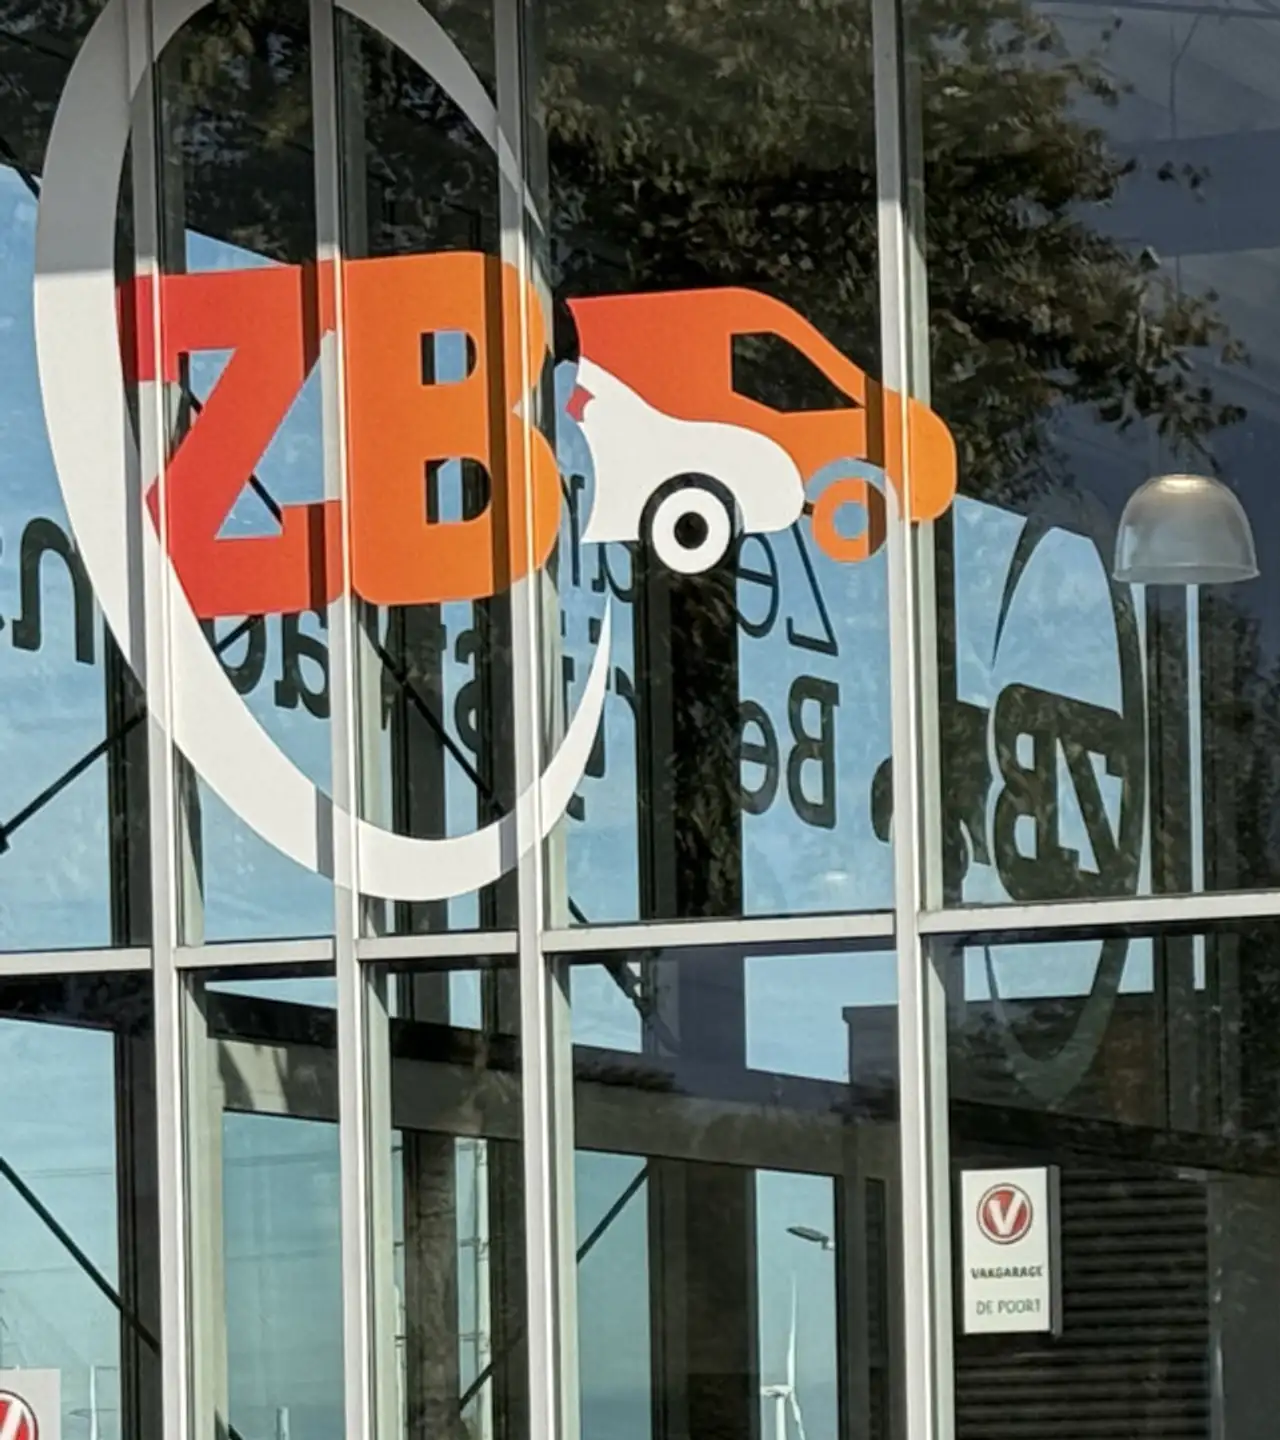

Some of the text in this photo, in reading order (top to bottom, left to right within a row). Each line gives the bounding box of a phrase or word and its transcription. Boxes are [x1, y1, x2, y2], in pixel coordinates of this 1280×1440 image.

[115, 251, 563, 619] ZB
[970, 1265, 1043, 1279] VAKGARAGE
[976, 1298, 1041, 1315] DE POORT
